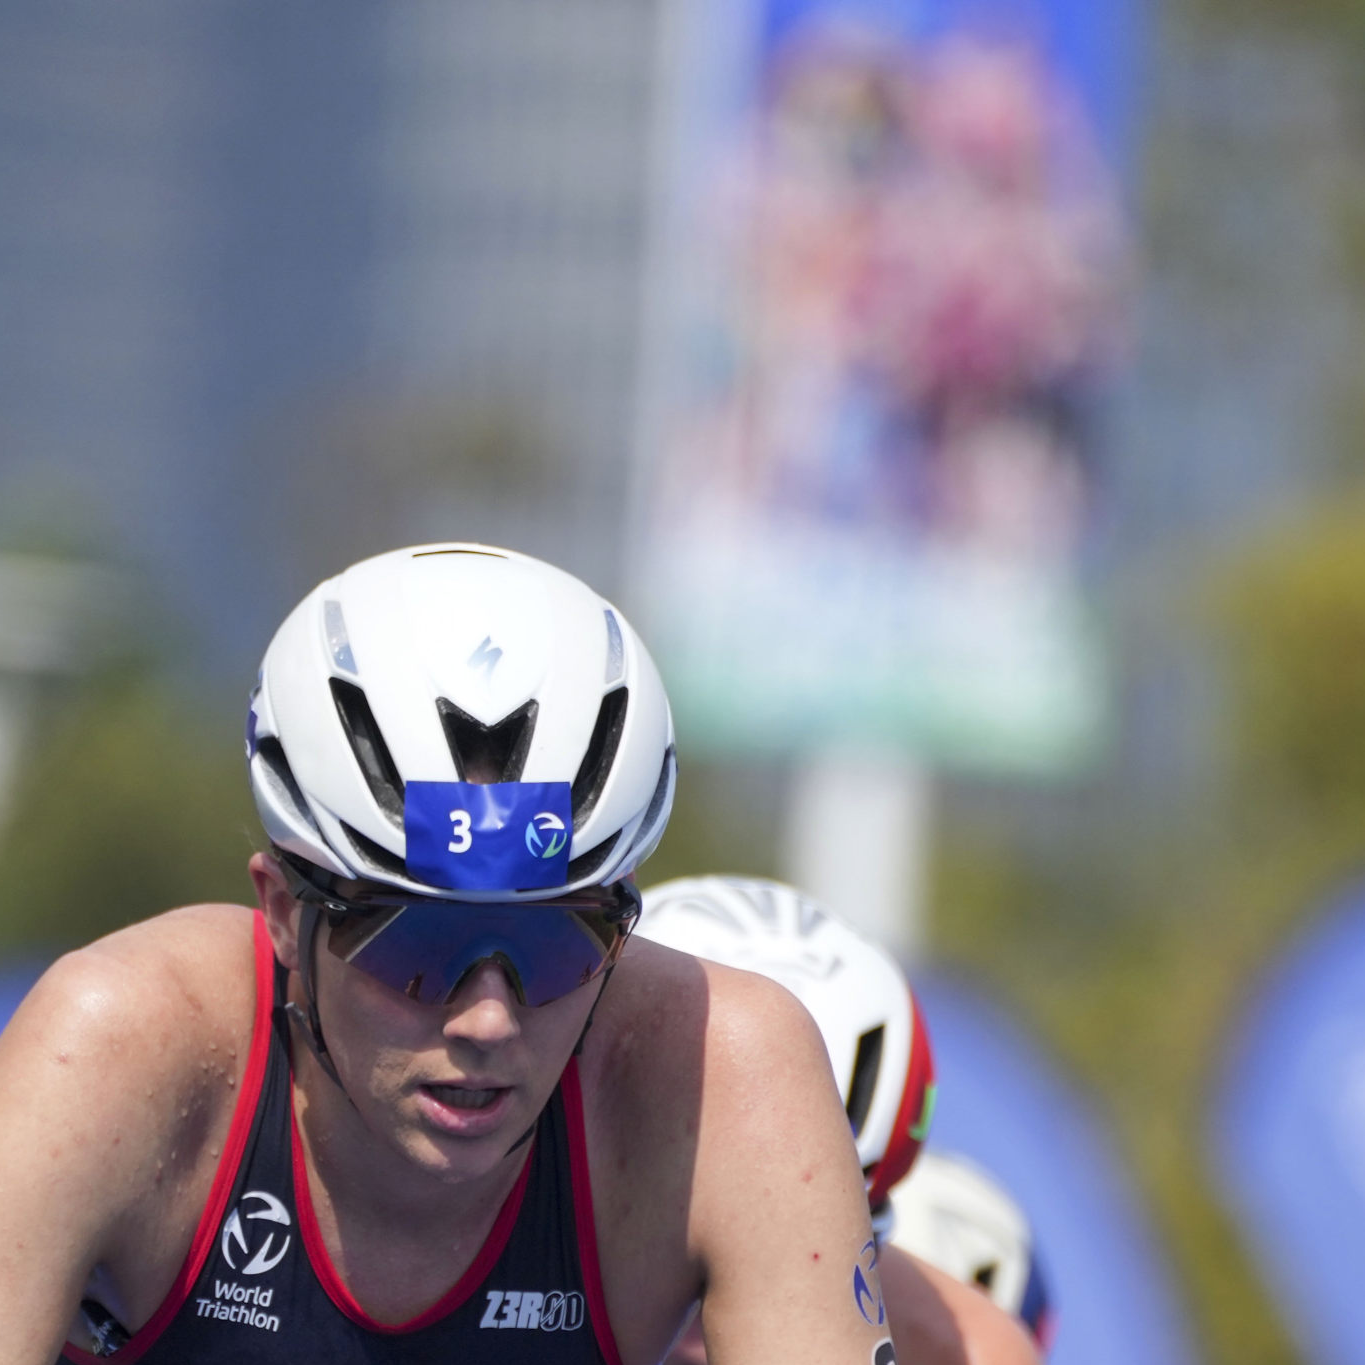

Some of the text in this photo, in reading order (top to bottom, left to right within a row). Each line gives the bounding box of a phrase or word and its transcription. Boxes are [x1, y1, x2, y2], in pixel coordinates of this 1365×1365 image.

[447, 810, 473, 854] 3
[215, 1279, 273, 1308] World
[196, 1299, 280, 1332] Triathlon
